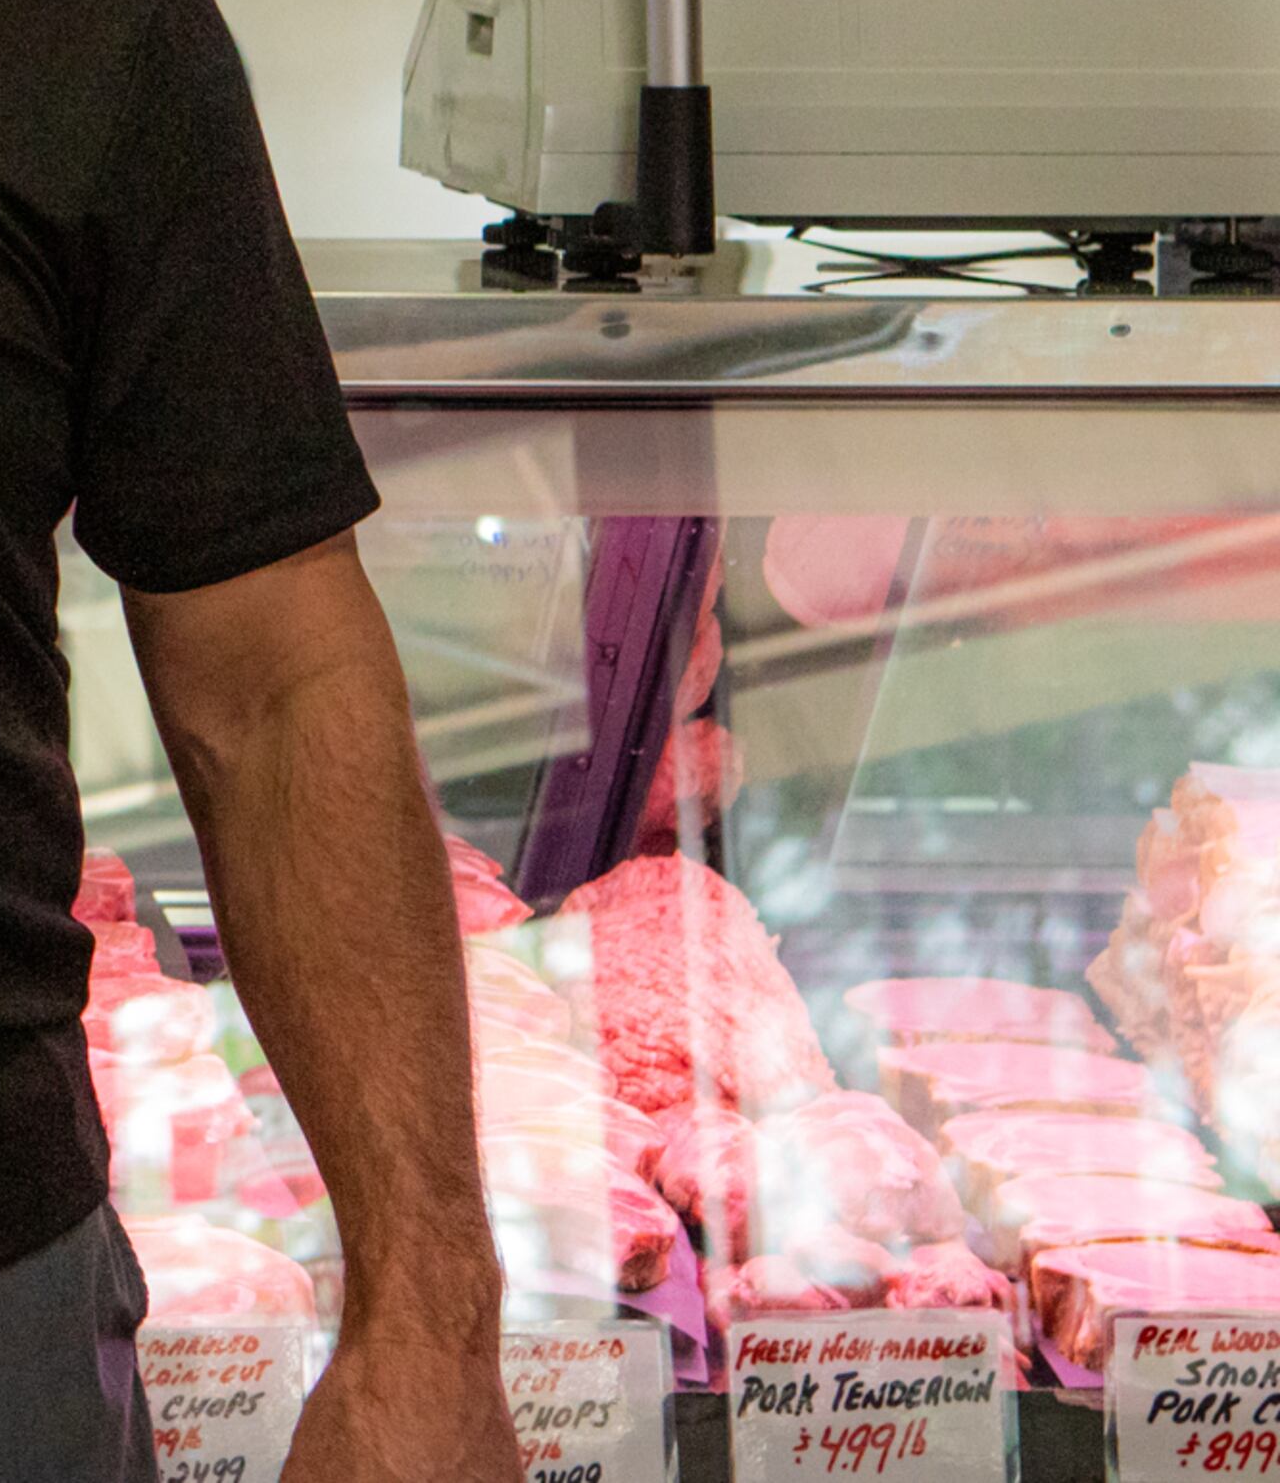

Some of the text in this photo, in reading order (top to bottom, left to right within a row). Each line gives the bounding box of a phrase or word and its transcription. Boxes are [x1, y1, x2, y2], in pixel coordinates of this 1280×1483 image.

[735, 1332, 813, 1371] FRESH
[1133, 1324, 1200, 1361] REAL
[161, 1390, 267, 1422] CHOPS
[737, 1372, 820, 1418] PORK
[1146, 1389, 1241, 1426] PORK
[514, 1397, 622, 1434] CHOPS
